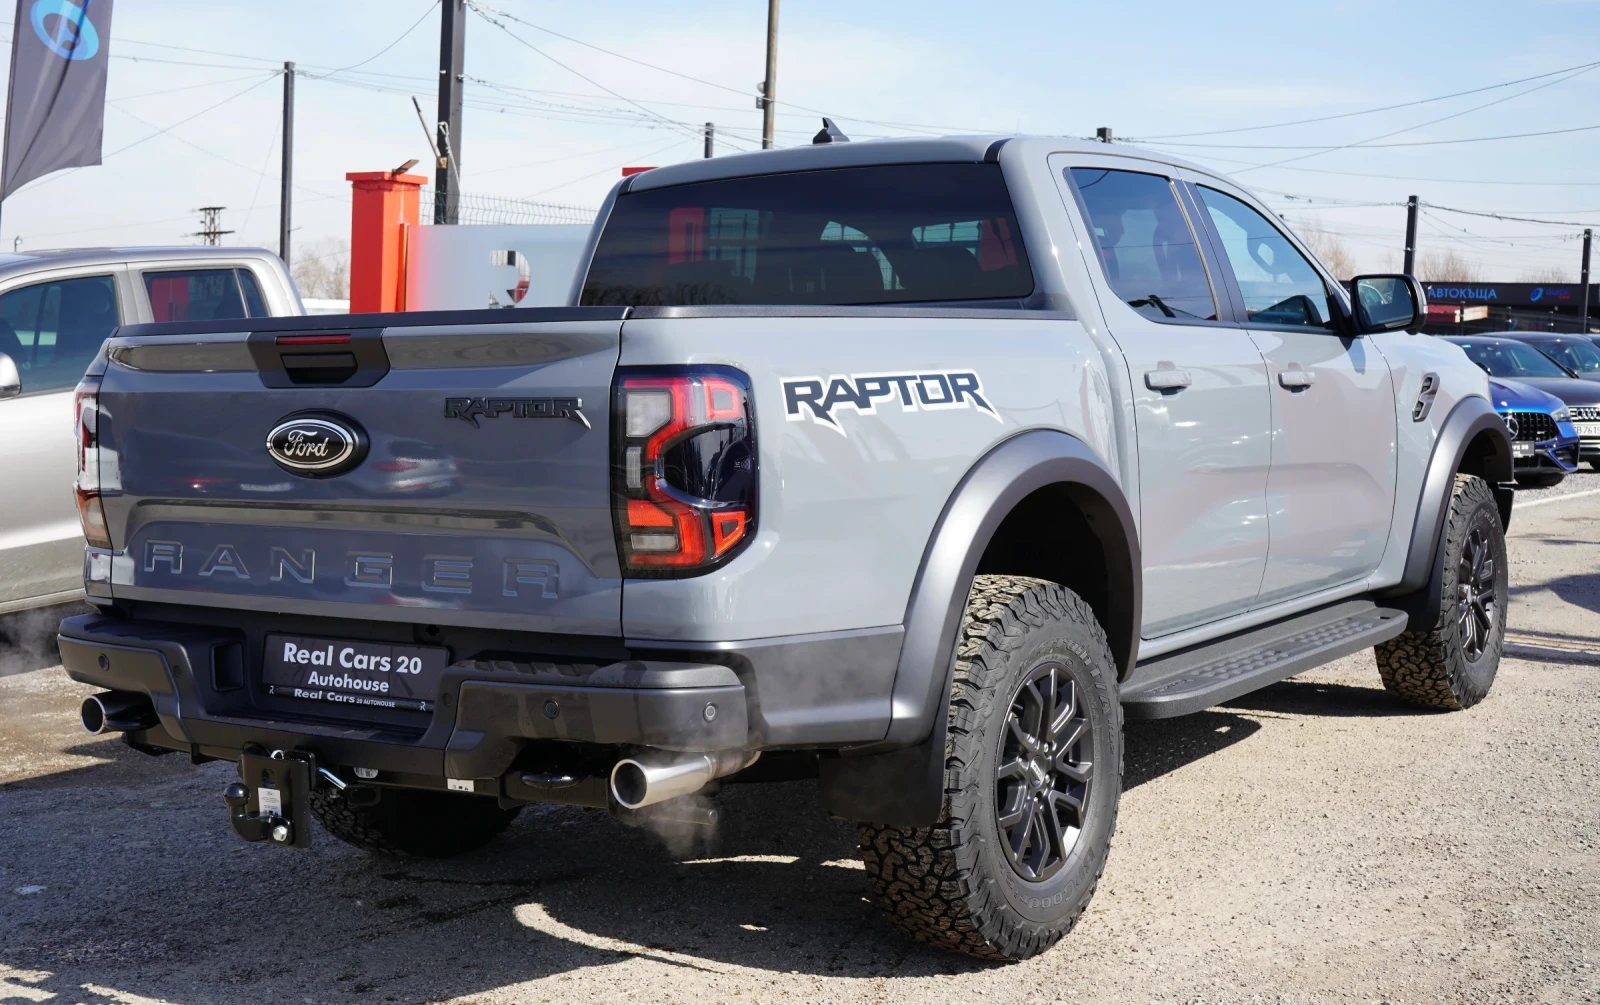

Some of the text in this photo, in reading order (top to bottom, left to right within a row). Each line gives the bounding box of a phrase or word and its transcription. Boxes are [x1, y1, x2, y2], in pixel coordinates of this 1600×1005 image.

[1428, 287, 1497, 300] АВТОКЪЩА
[445, 397, 591, 429] RAPTOR
[780, 369, 1003, 437] RAPTOR
[284, 430, 329, 458] Ford
[143, 540, 560, 598] RANGER
[283, 643, 422, 674] Real Cars 20
[308, 671, 389, 692] Autohouse
[294, 688, 323, 700] Real
[326, 692, 355, 703] Cars
[363, 699, 395, 708] AUTOHOUSE
